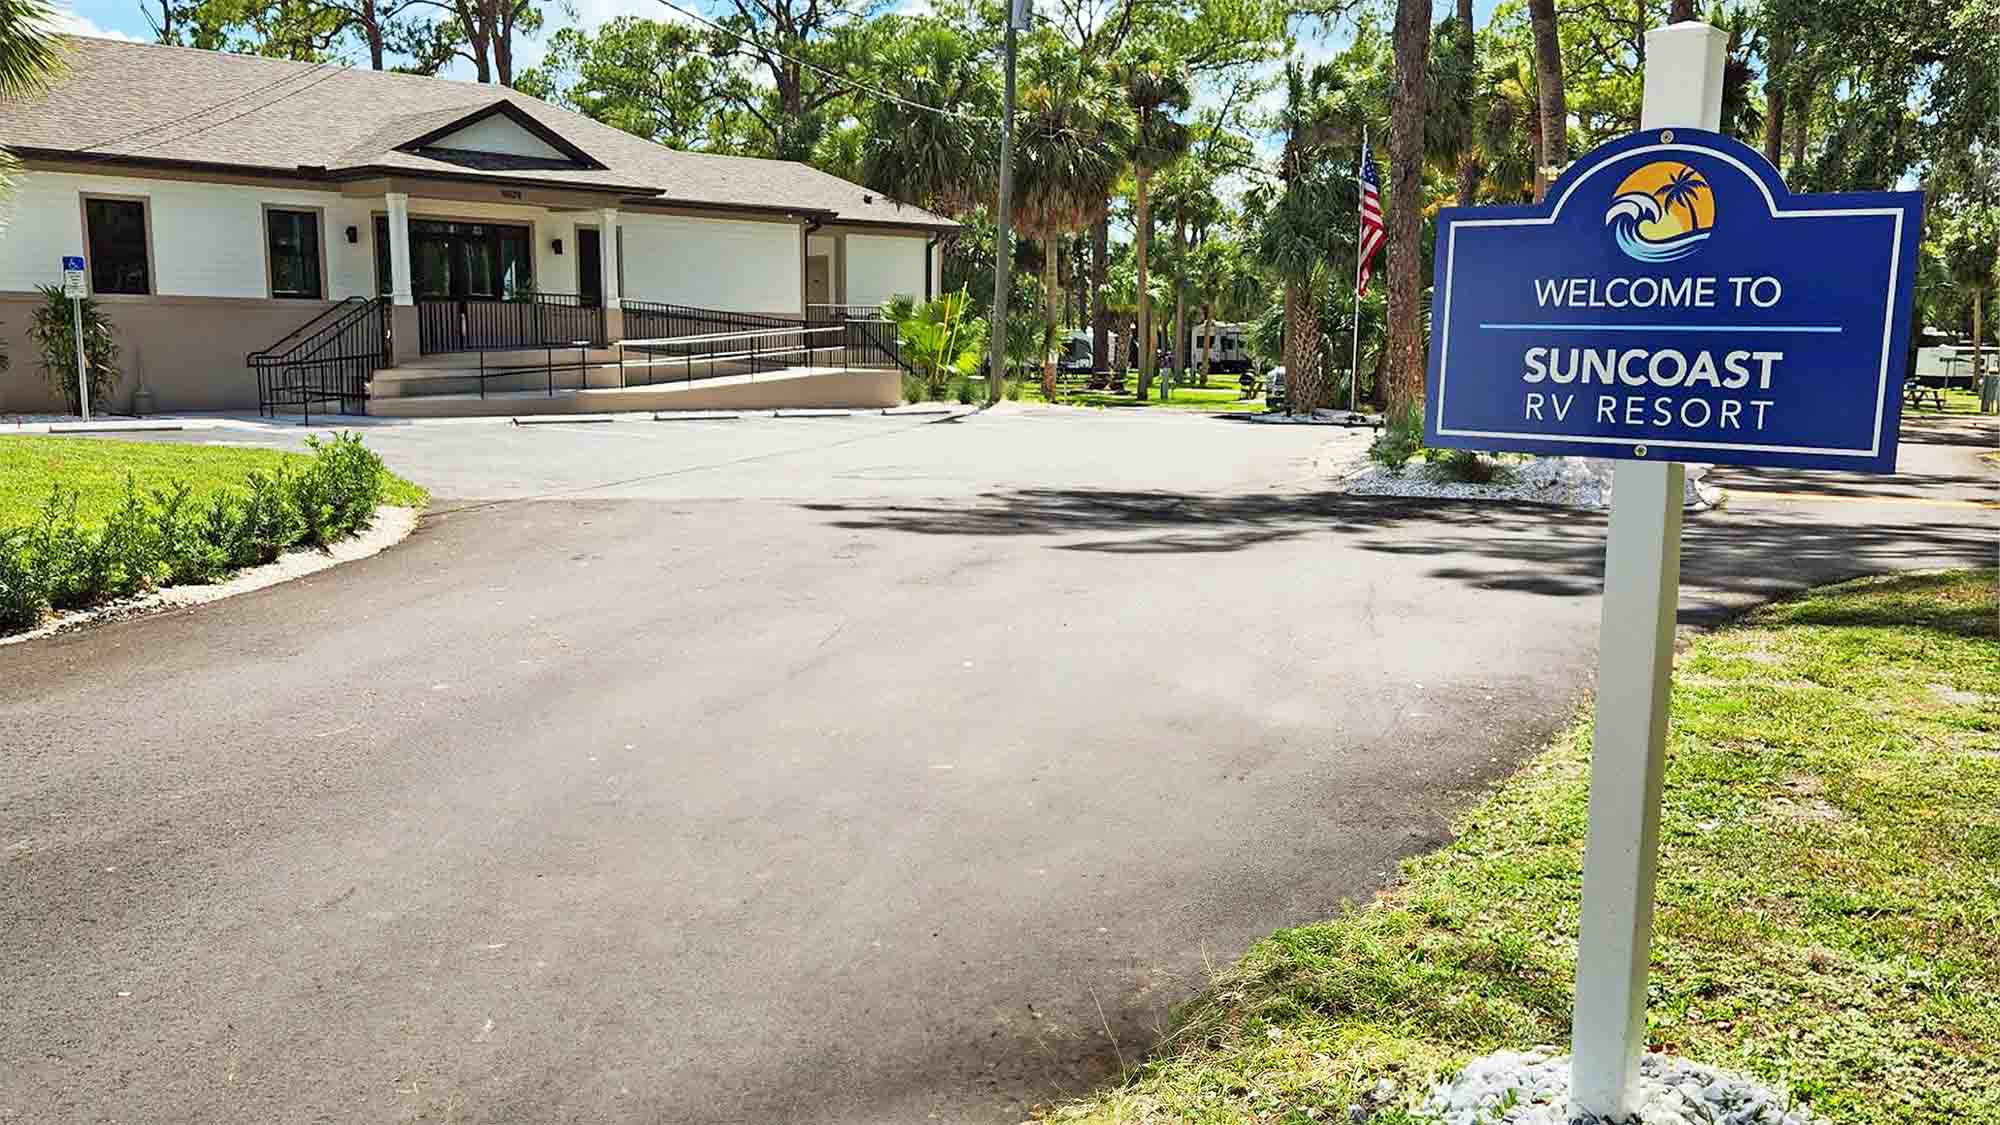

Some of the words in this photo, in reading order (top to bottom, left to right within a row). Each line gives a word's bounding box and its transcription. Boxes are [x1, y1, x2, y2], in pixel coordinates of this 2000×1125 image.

[1534, 277, 1717, 308] WELCOME
[1728, 276, 1783, 308] TO
[1522, 347, 1784, 389] SUNCOAST
[1525, 392, 1574, 422] RV
[1597, 394, 1774, 430] RESORT
